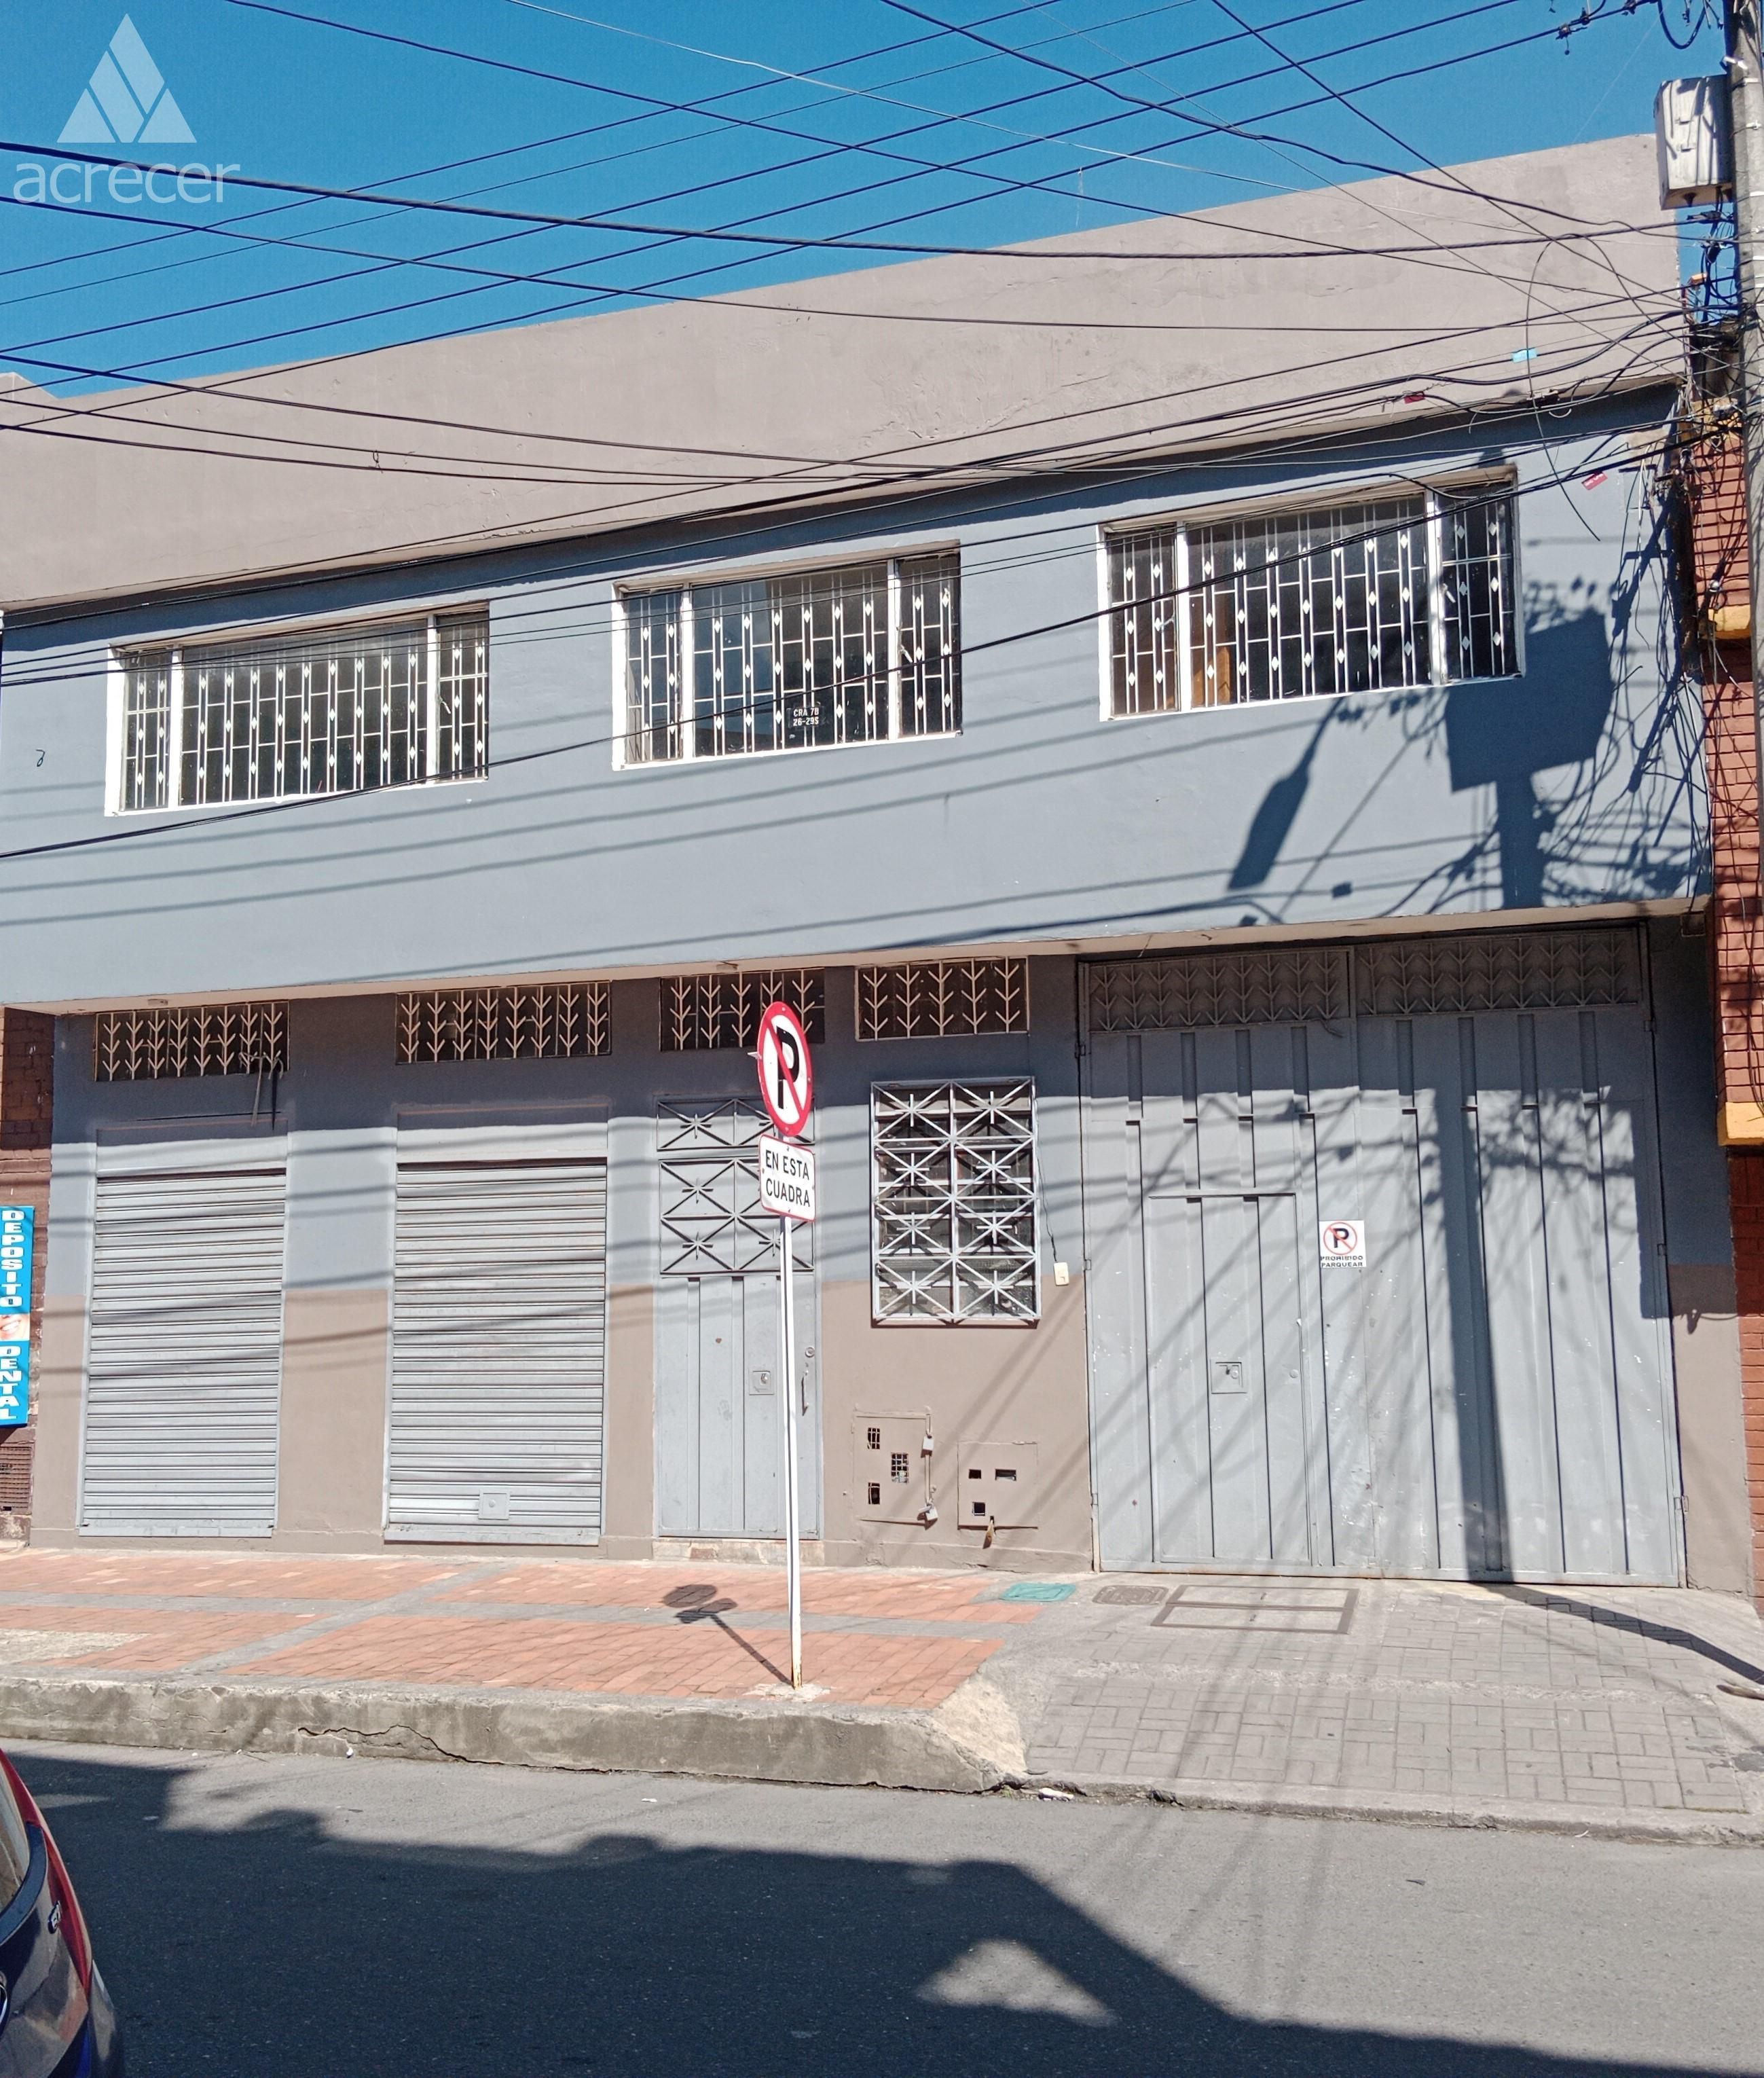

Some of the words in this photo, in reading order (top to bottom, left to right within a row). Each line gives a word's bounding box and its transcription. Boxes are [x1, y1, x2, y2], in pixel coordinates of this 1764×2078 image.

[793, 708, 808, 717] CRA
[765, 1150, 779, 1171] EN
[783, 1155, 809, 1180] ESTA
[766, 1178, 810, 1207] CUADRA
[0, 1210, 24, 1307] DEPOSITO
[0, 1346, 22, 1420] DENTAL
